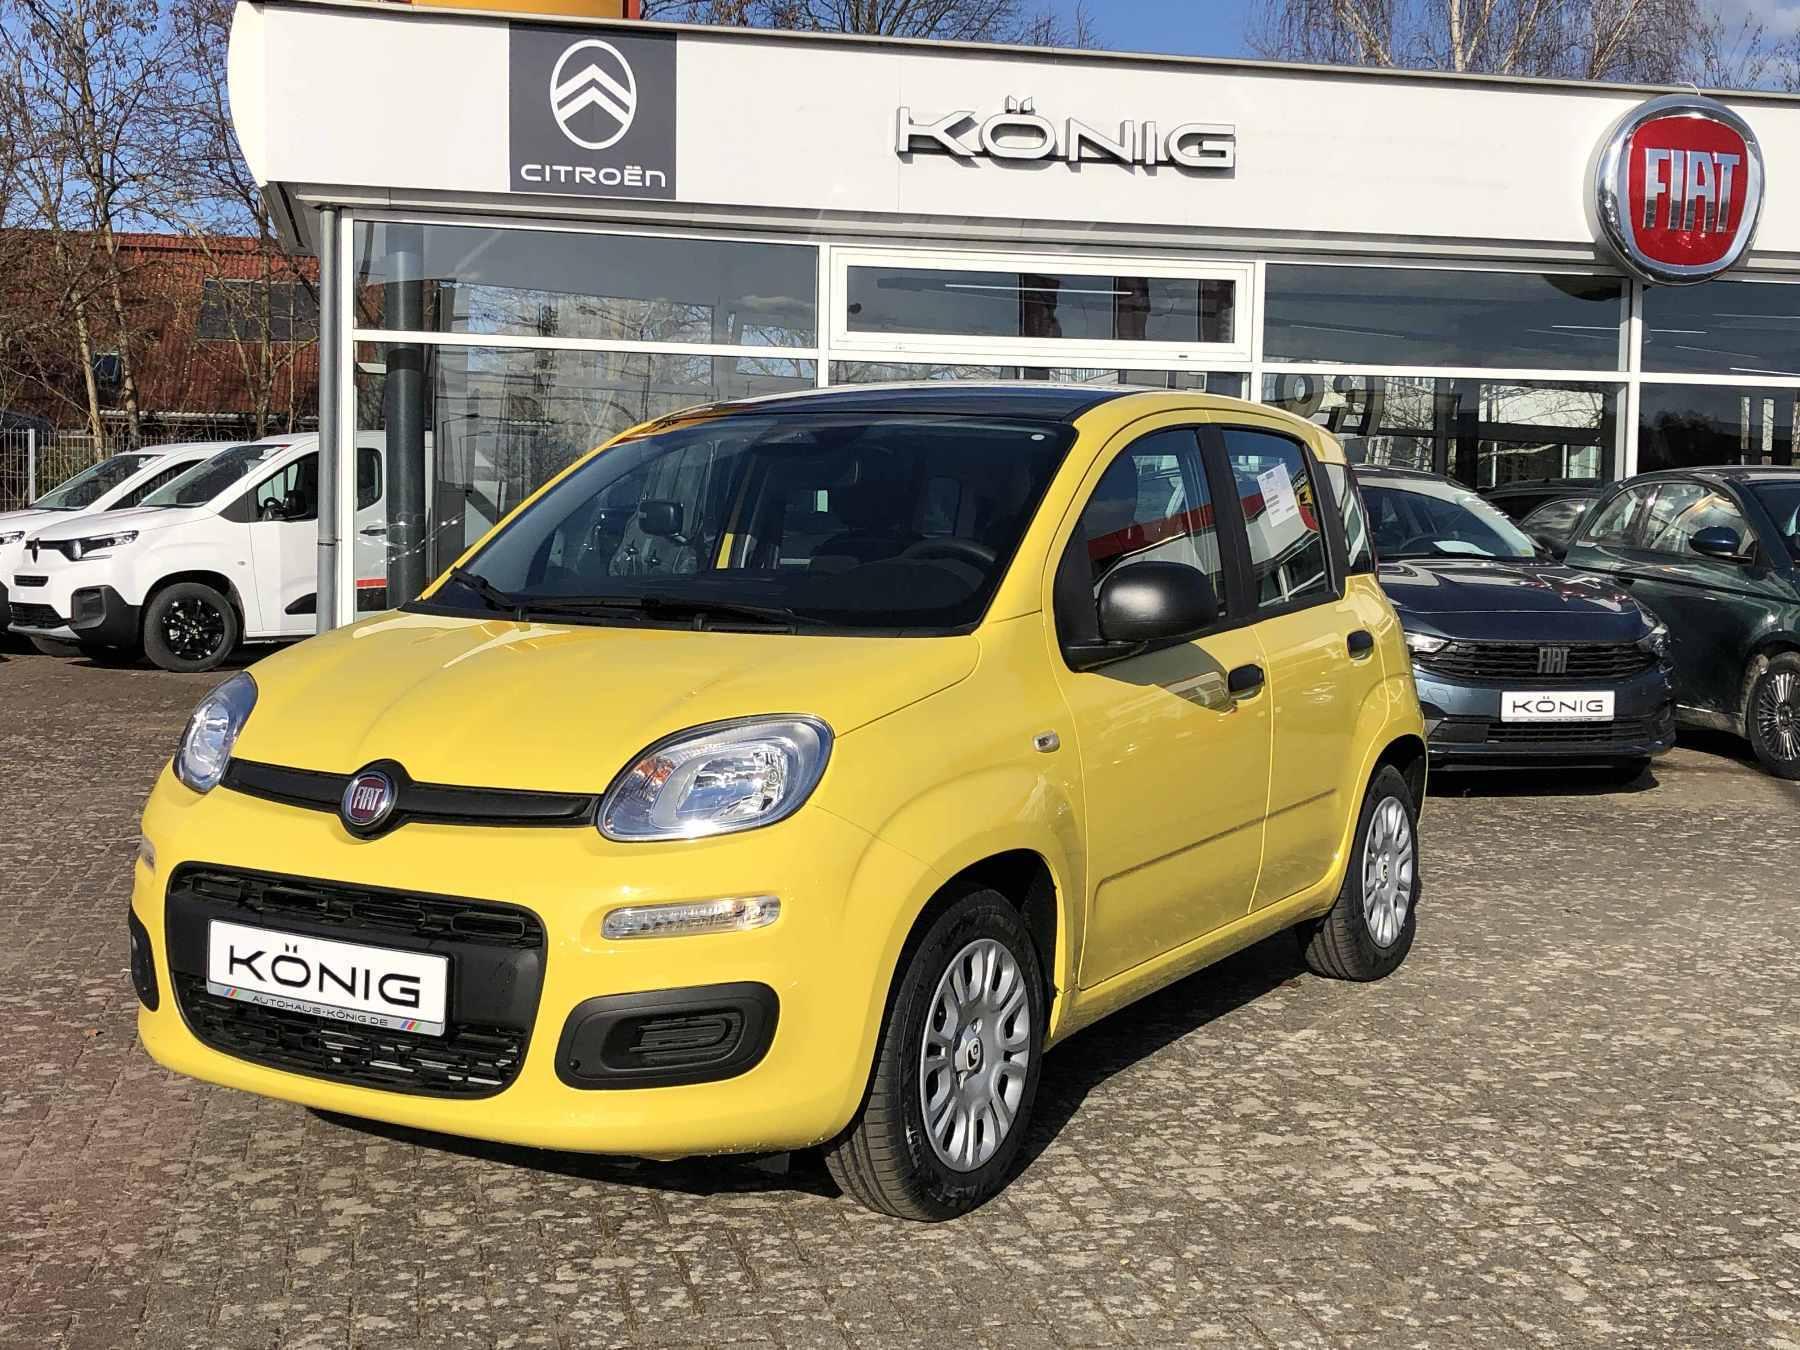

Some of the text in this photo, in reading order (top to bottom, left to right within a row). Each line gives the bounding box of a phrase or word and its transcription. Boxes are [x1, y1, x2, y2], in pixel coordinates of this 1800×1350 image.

[896, 95, 1236, 168] KÖNIG
[1643, 148, 1740, 233] FIAT
[1537, 646, 1571, 674] FIAT
[1512, 695, 1604, 713] KÖNIG
[353, 786, 384, 811] FIAT
[228, 943, 421, 1009] KÖNIG
